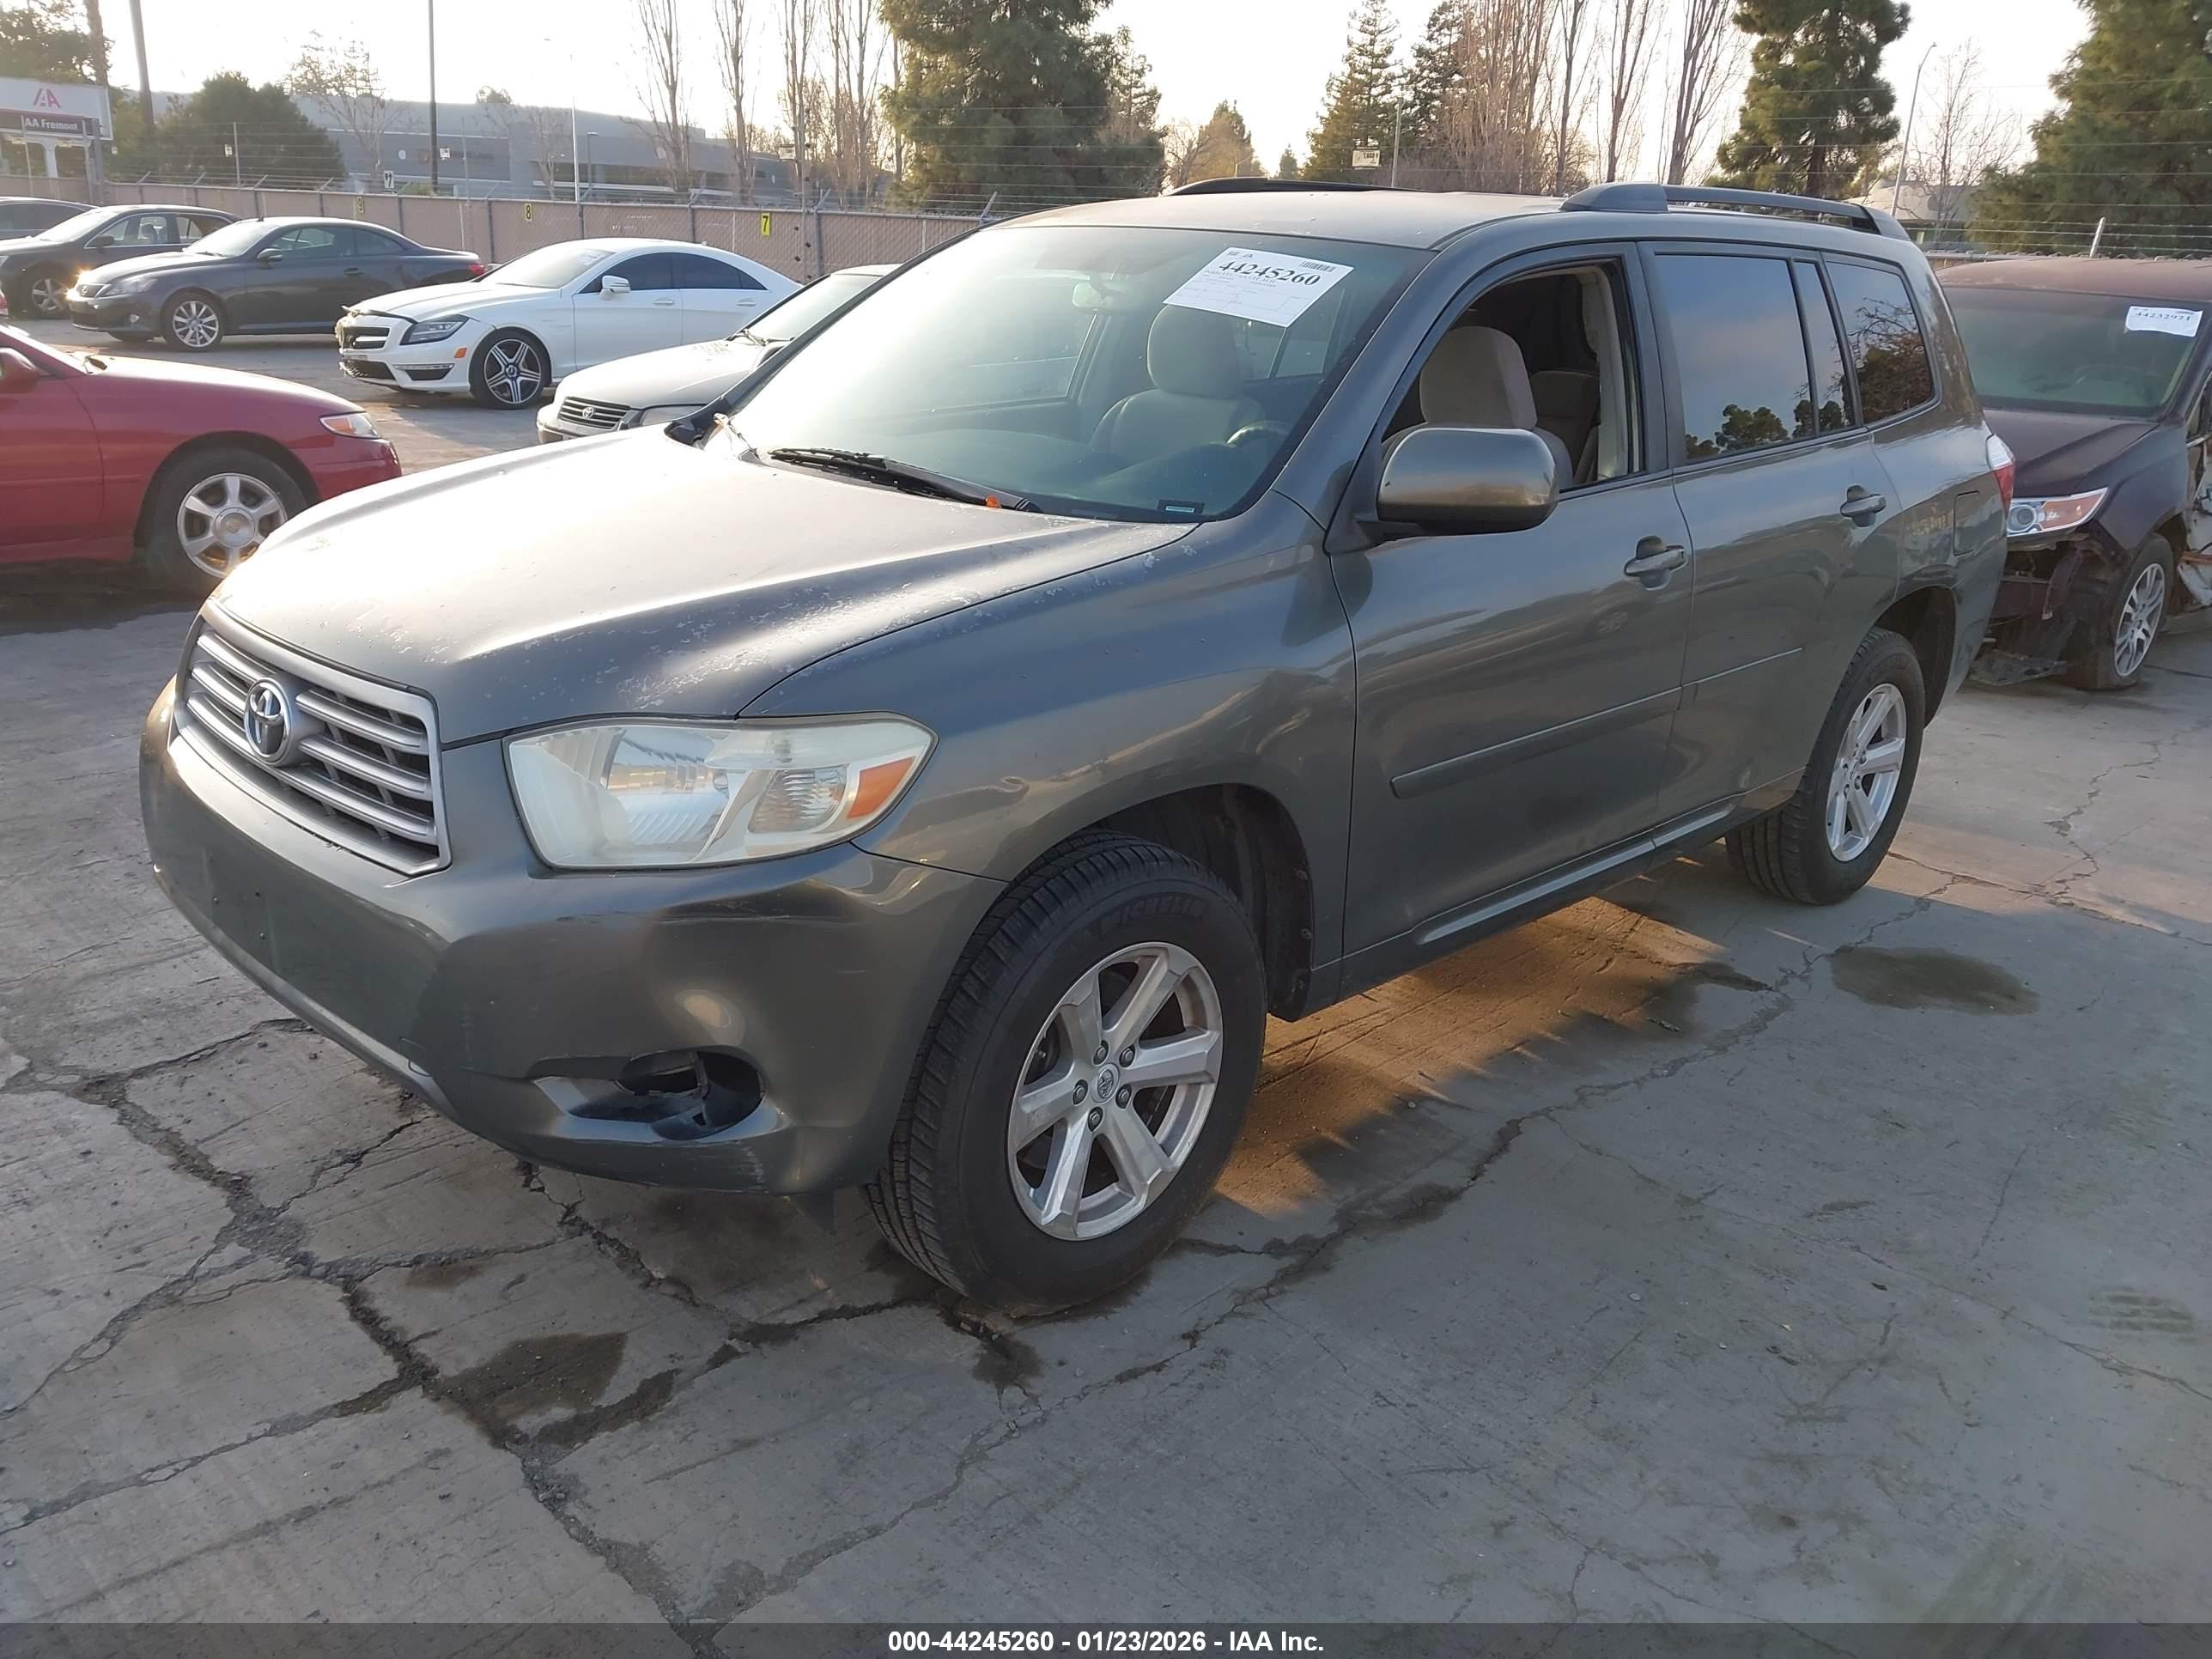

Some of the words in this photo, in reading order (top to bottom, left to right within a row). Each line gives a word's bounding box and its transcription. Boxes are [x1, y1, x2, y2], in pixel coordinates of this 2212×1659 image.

[40, 118, 77, 130] Fremont
[526, 205, 532, 220] 8
[763, 215, 769, 233] 7
[1218, 260, 1322, 287] 44245260
[1101, 895, 1208, 934] MICHELIN
